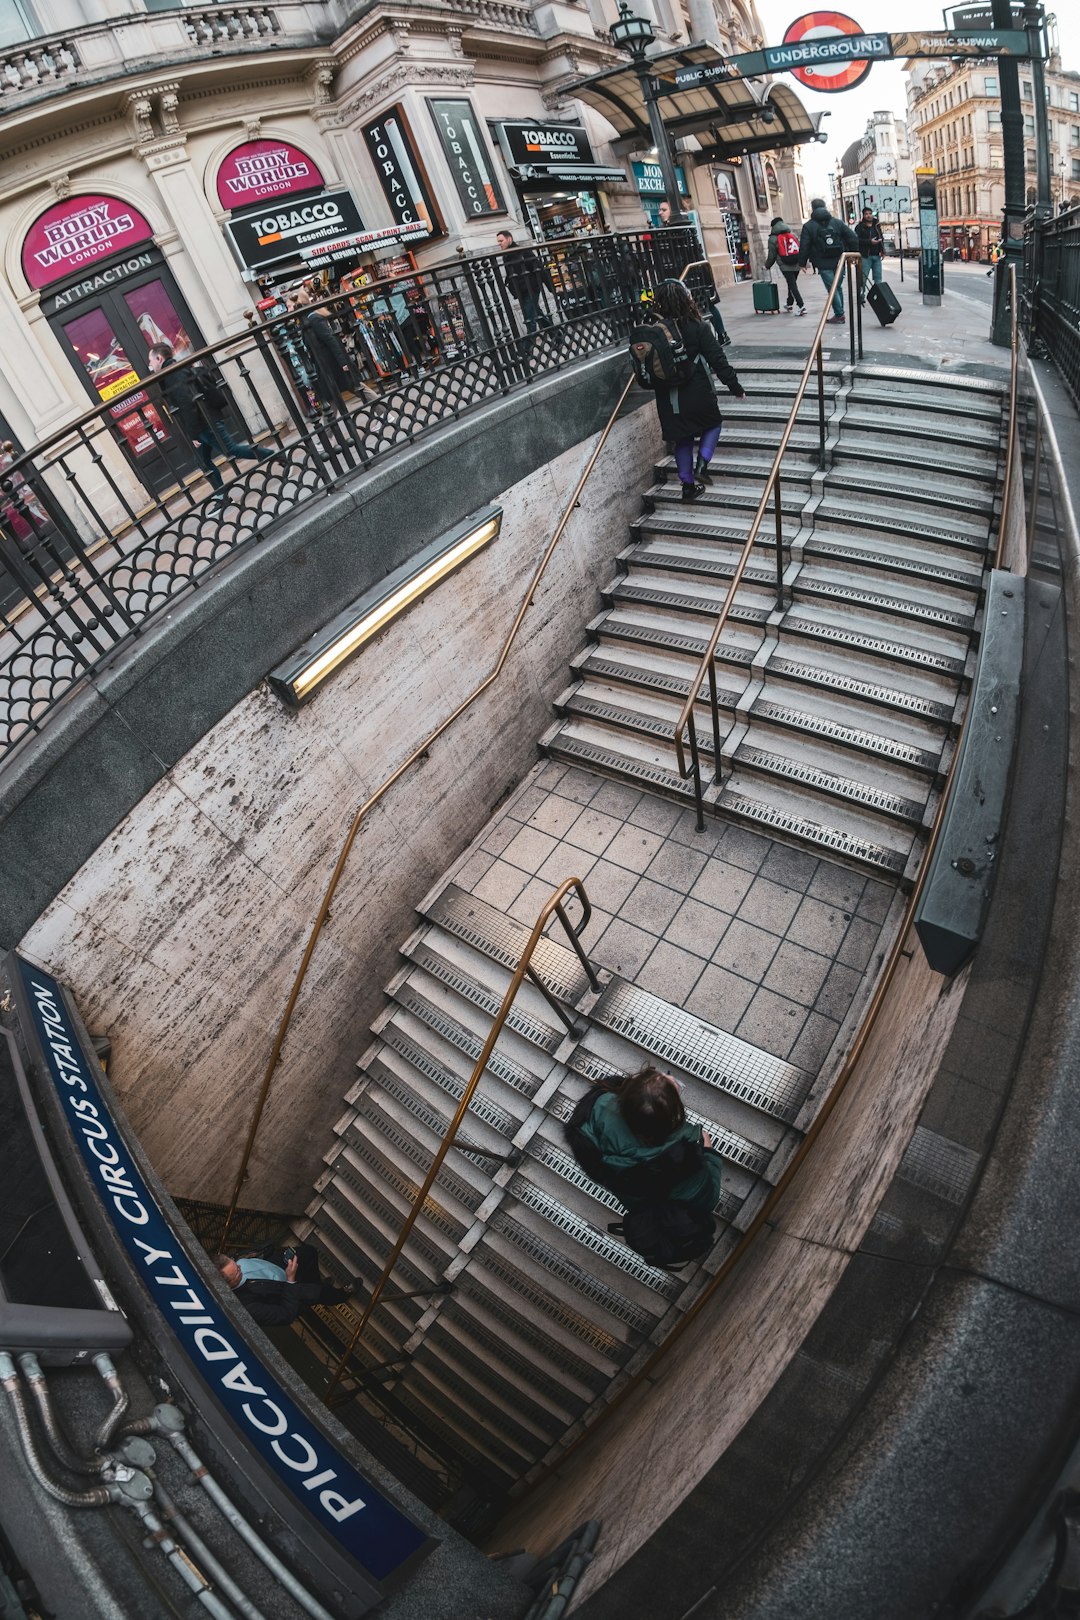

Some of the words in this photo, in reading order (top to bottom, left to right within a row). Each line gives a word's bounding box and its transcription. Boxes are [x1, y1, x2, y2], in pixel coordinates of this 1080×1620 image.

[770, 39, 884, 65] UNDERGROUND
[920, 38, 955, 47] PUBLIC
[957, 37, 998, 46] SUBWAY
[675, 70, 703, 85] PUBLIC
[704, 63, 738, 78] SUBWAY
[521, 131, 576, 146] TOBACCO
[235, 151, 290, 176] BODY
[370, 127, 413, 224] TOBACC
[441, 113, 482, 213] TOBACCO
[643, 165, 664, 178] MON
[225, 162, 310, 193] WORLDS
[255, 181, 292, 196] LONDON
[44, 204, 111, 246] BODY
[250, 201, 339, 237] TOBACCO
[33, 213, 135, 268] WORLDS
[296, 225, 348, 244] Essentials...
[311, 247, 326, 256] SIM
[327, 239, 351, 252] CARDS
[355, 233, 374, 243] SCAN
[382, 227, 401, 237] PRINT
[69, 240, 113, 265] LONDON
[307, 256, 332, 269] MOBILE
[331, 247, 356, 261] REPAIRS
[55, 253, 153, 309] ATTRACTION
[112, 379, 138, 394] ATTRACTION
[31, 981, 87, 1092] STATION
[69, 1095, 149, 1225] CIRCUS
[133, 1237, 367, 1523] PICCADILLY
